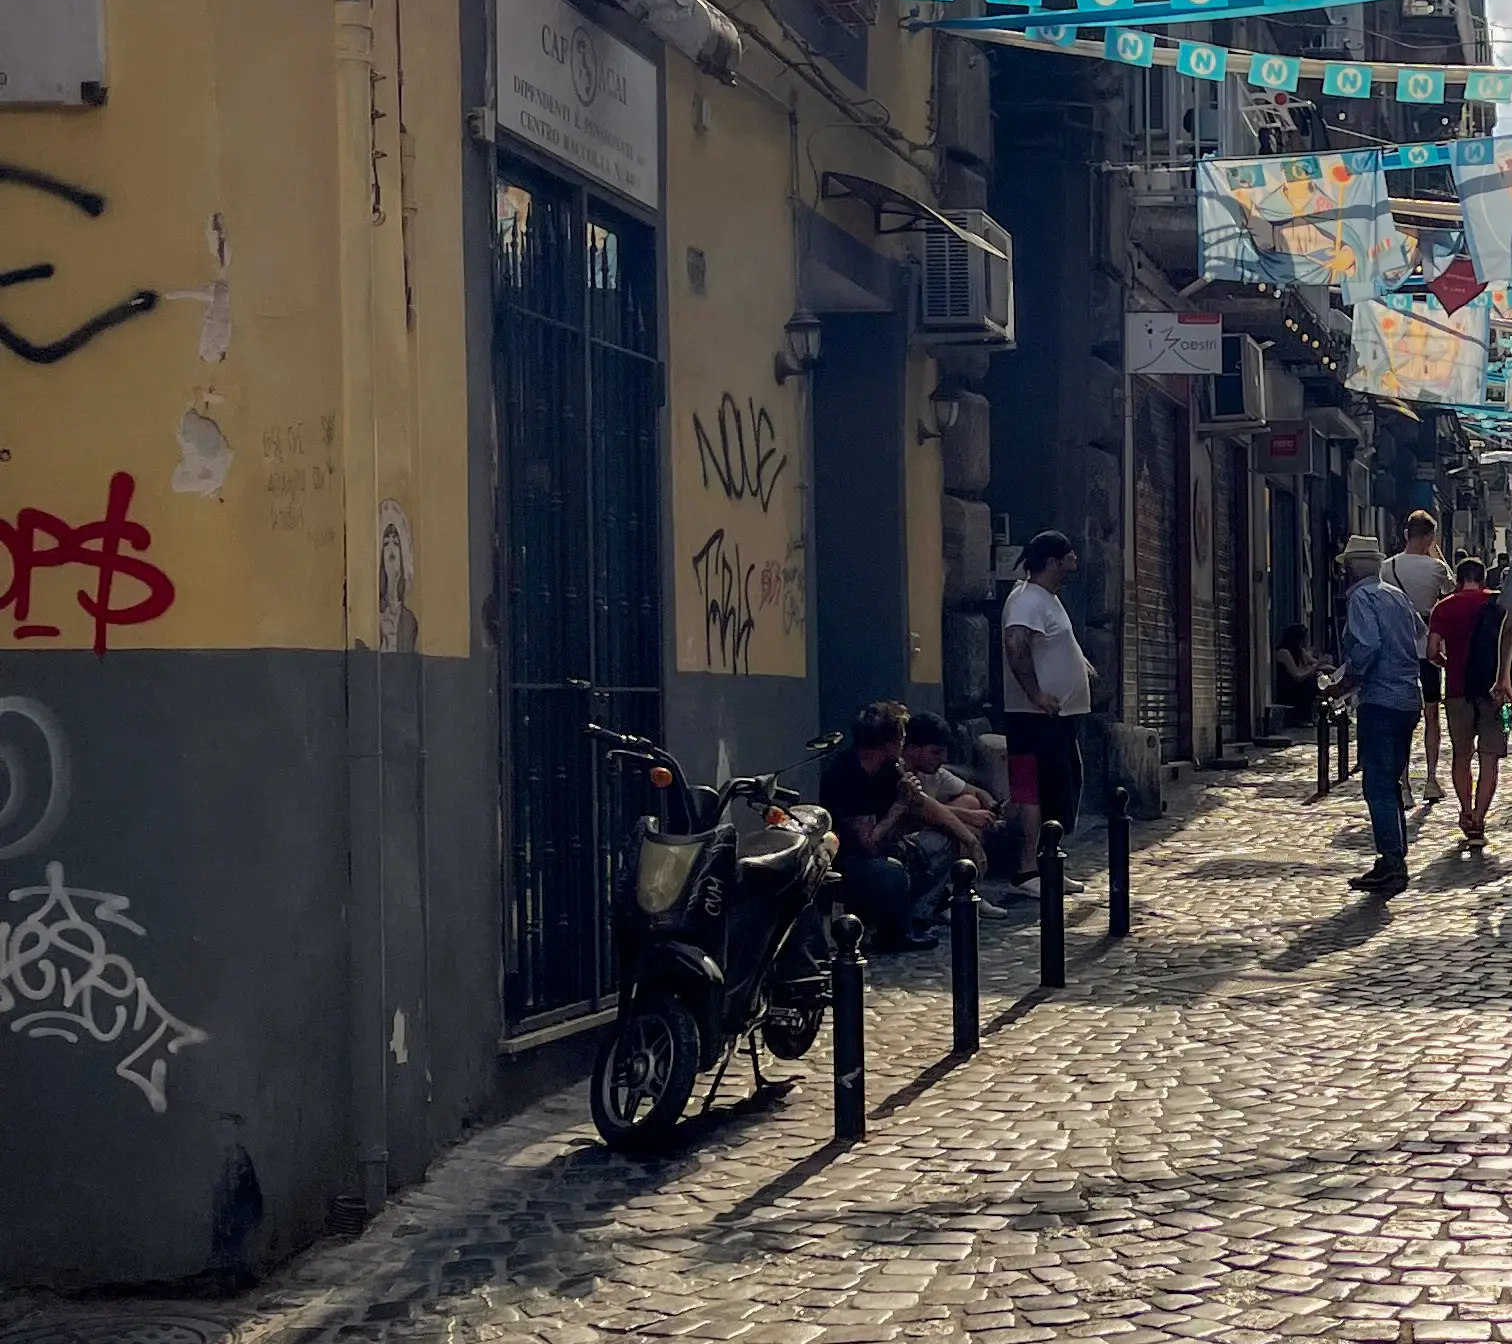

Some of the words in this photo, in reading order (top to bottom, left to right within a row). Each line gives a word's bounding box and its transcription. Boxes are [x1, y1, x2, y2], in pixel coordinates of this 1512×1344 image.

[1122, 37, 1138, 57] N
[1196, 52, 1211, 69] N
[1267, 63, 1282, 80] N
[1342, 73, 1358, 89] N
[1414, 77, 1428, 94] N
[1483, 78, 1496, 93] N
[513, 75, 571, 123] DIPENDENTI
[520, 110, 559, 144] CENTRO
